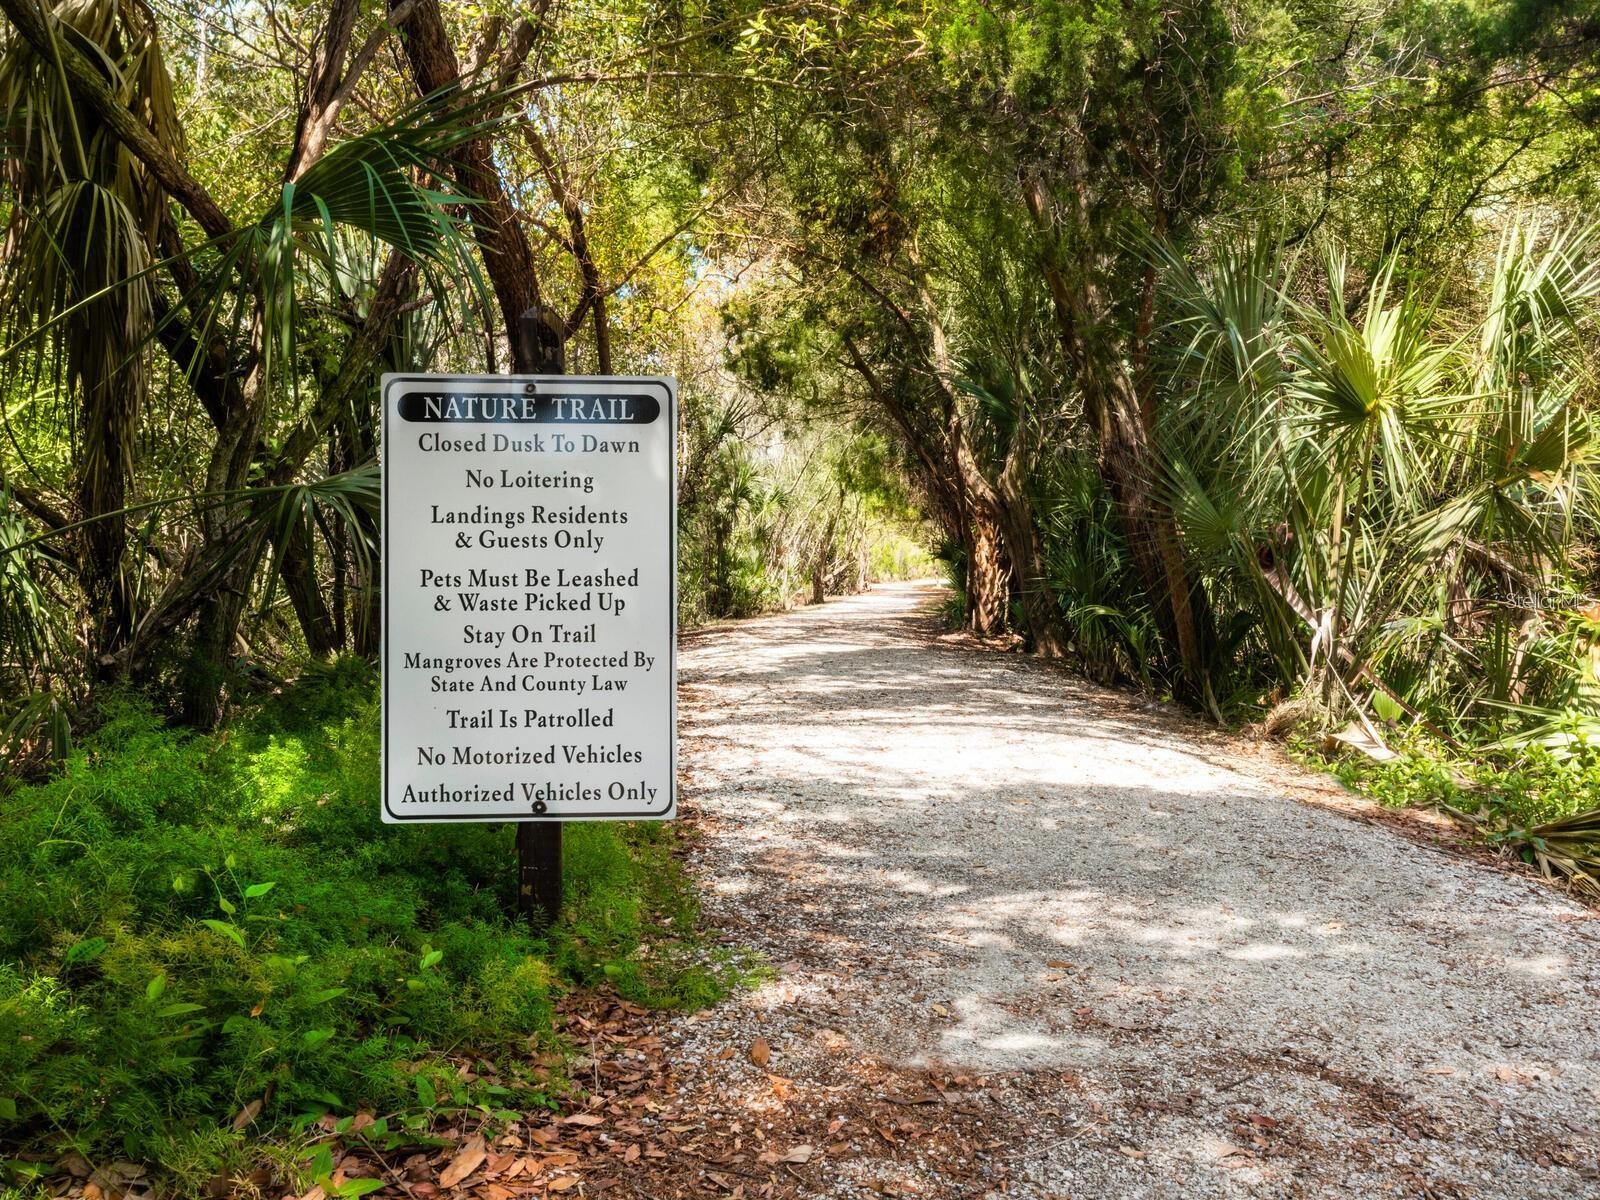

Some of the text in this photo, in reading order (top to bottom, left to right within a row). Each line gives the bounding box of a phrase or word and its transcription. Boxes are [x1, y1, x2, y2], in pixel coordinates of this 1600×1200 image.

[424, 397, 635, 420] NATURE TRAIL
[418, 433, 640, 454] Closed Dusk To Dawn
[465, 470, 594, 493] No Loitering
[431, 505, 628, 528] Landings Residents
[455, 529, 604, 553] & Guests Only
[420, 568, 639, 588] Pets Must Be Leashed
[433, 592, 626, 616] & Waste Picked Up
[463, 624, 596, 648] Stay On Trail
[403, 651, 655, 673] Mangroves Are Protected By
[431, 675, 628, 695] State And County Law
[446, 708, 614, 729] Trail Is Patrolled
[417, 744, 642, 766] No Motorized Vehicles
[401, 781, 658, 804] Authorized Vehicles Only
